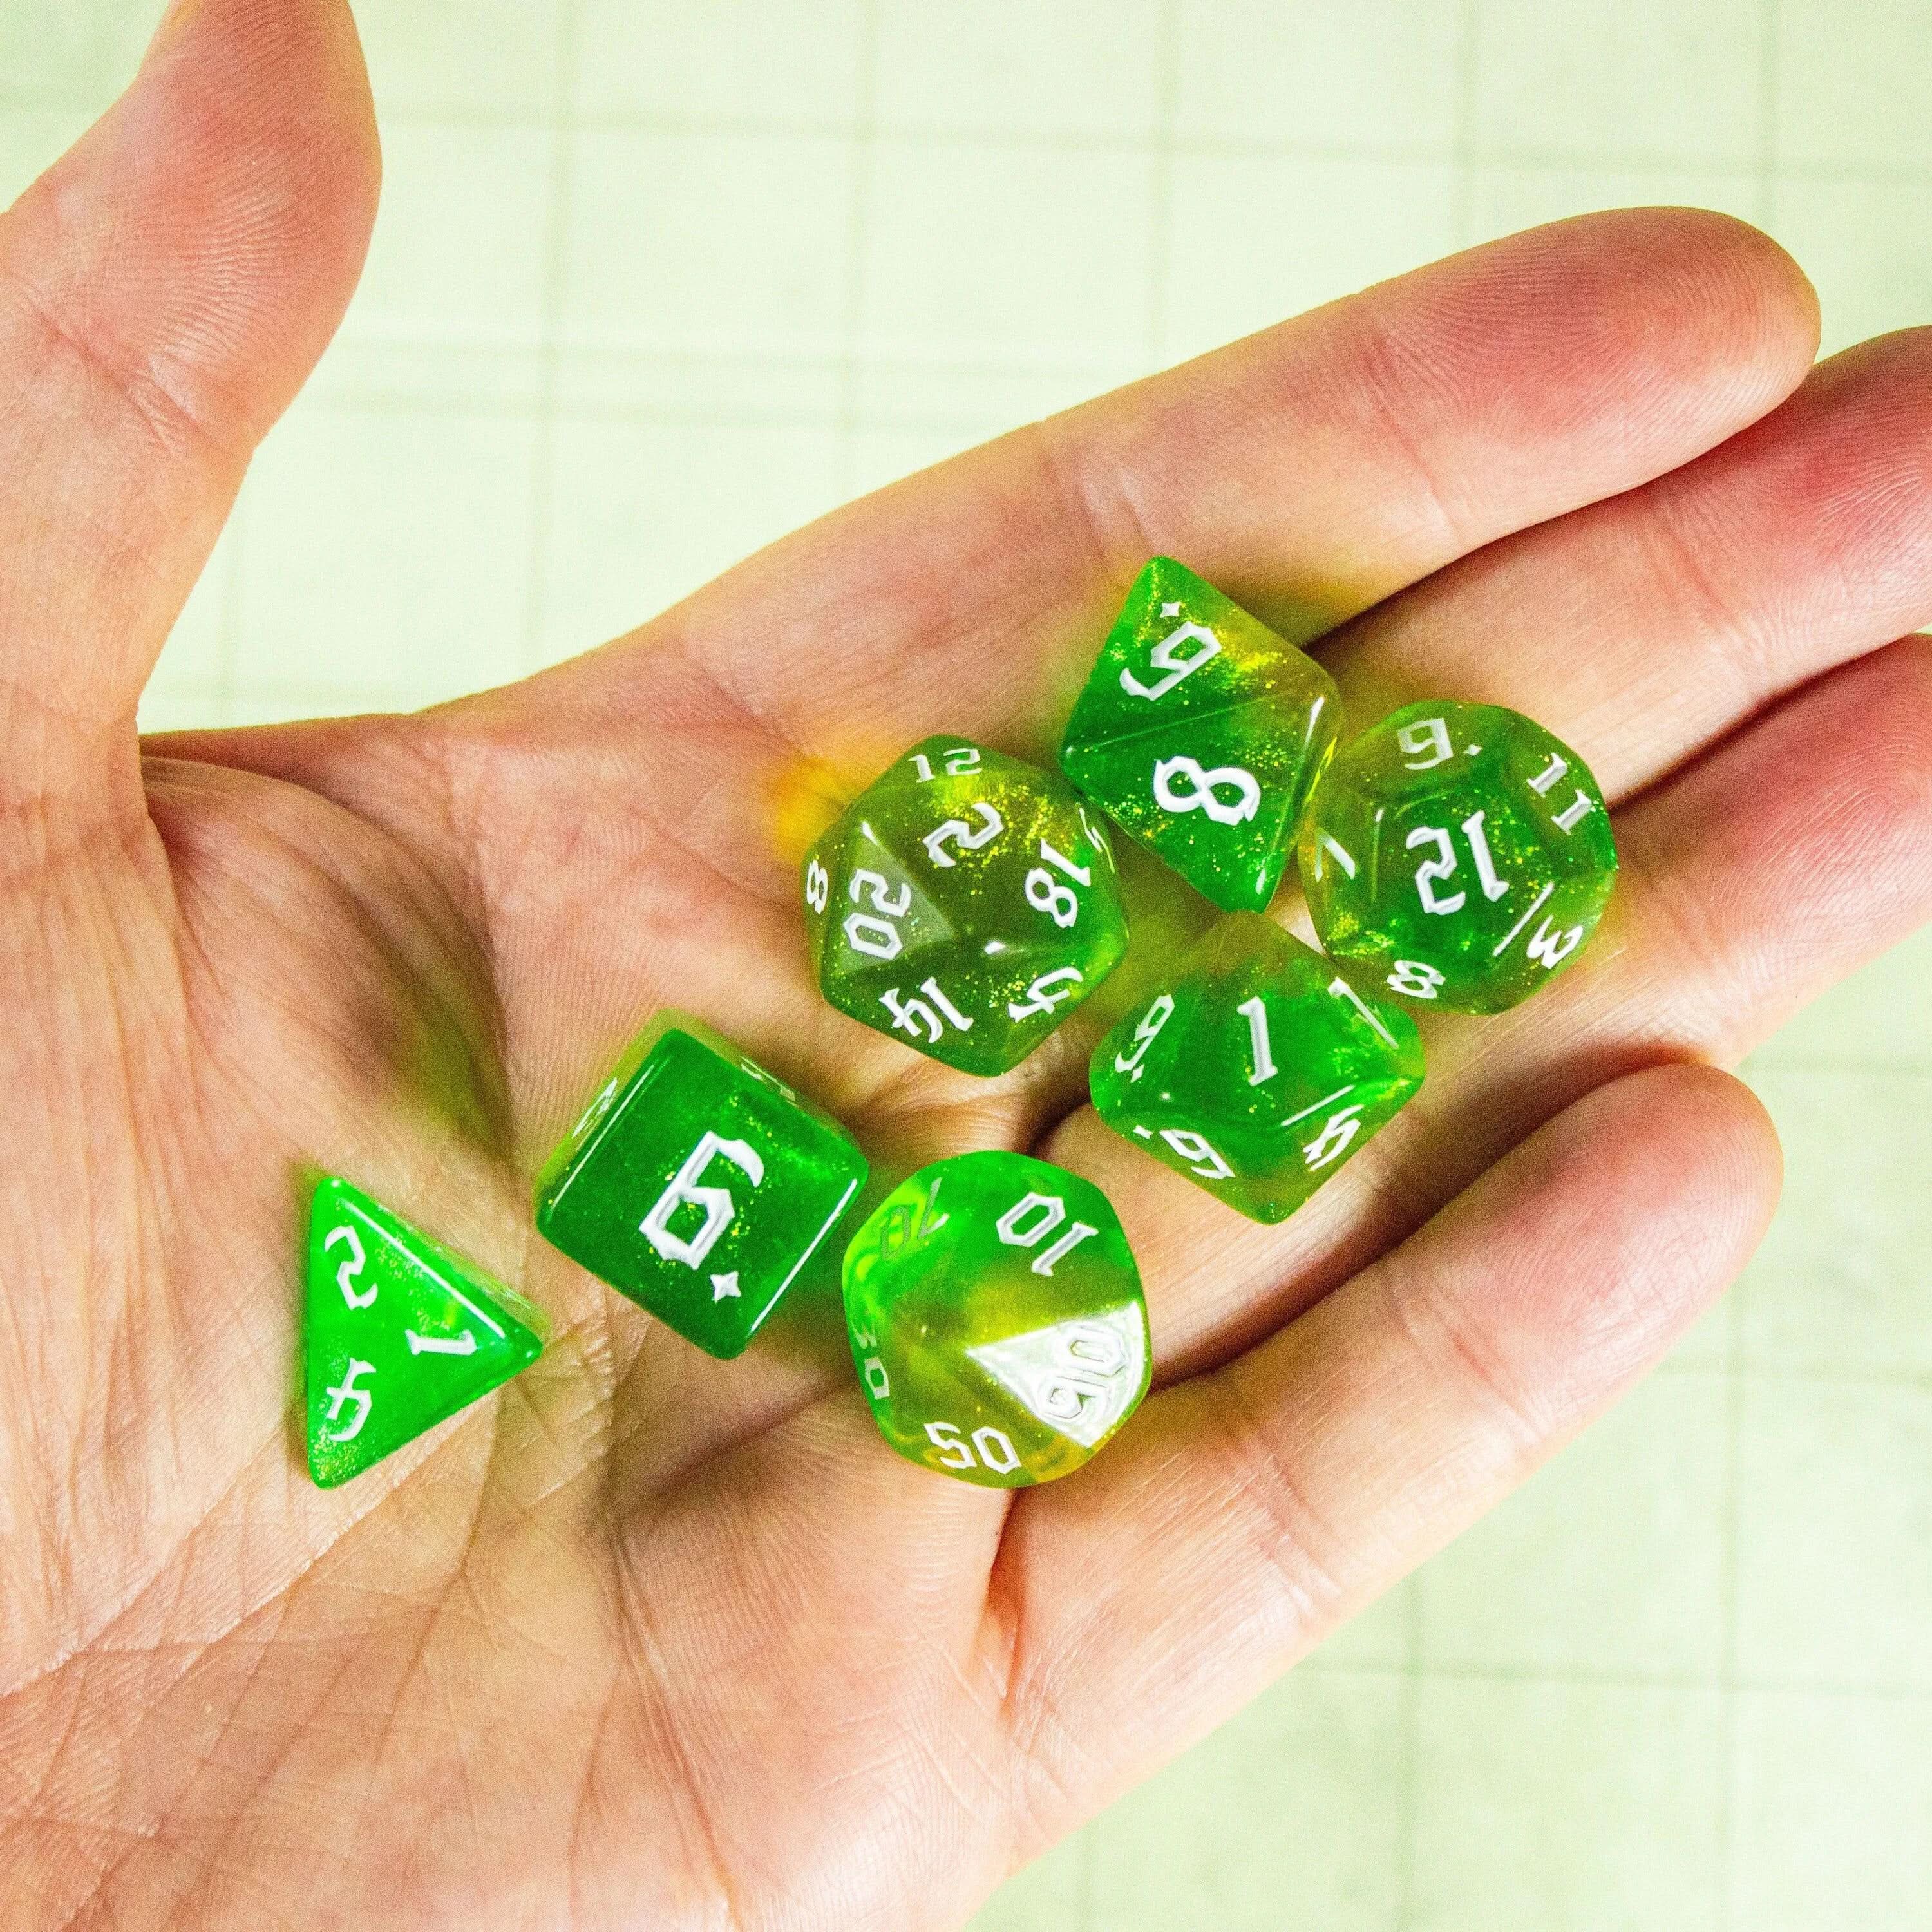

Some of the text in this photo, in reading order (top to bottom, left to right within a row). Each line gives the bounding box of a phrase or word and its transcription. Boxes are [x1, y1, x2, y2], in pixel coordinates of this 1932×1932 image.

[908, 748, 982, 783] 12
[1152, 756, 1261, 826] 8
[1526, 753, 1591, 835] 11
[923, 802, 1004, 867] 2
[1406, 810, 1510, 916] 12
[843, 869, 911, 960] 20
[1025, 838, 1091, 929] 18
[879, 977, 974, 1044] 14
[1387, 960, 1446, 999] 8
[1237, 996, 1278, 1087] 1
[324, 1225, 379, 1310] 2
[996, 1191, 1099, 1276] 10
[404, 1329, 477, 1356] 1
[325, 1357, 377, 1442] 4
[923, 1421, 1022, 1474] 50
